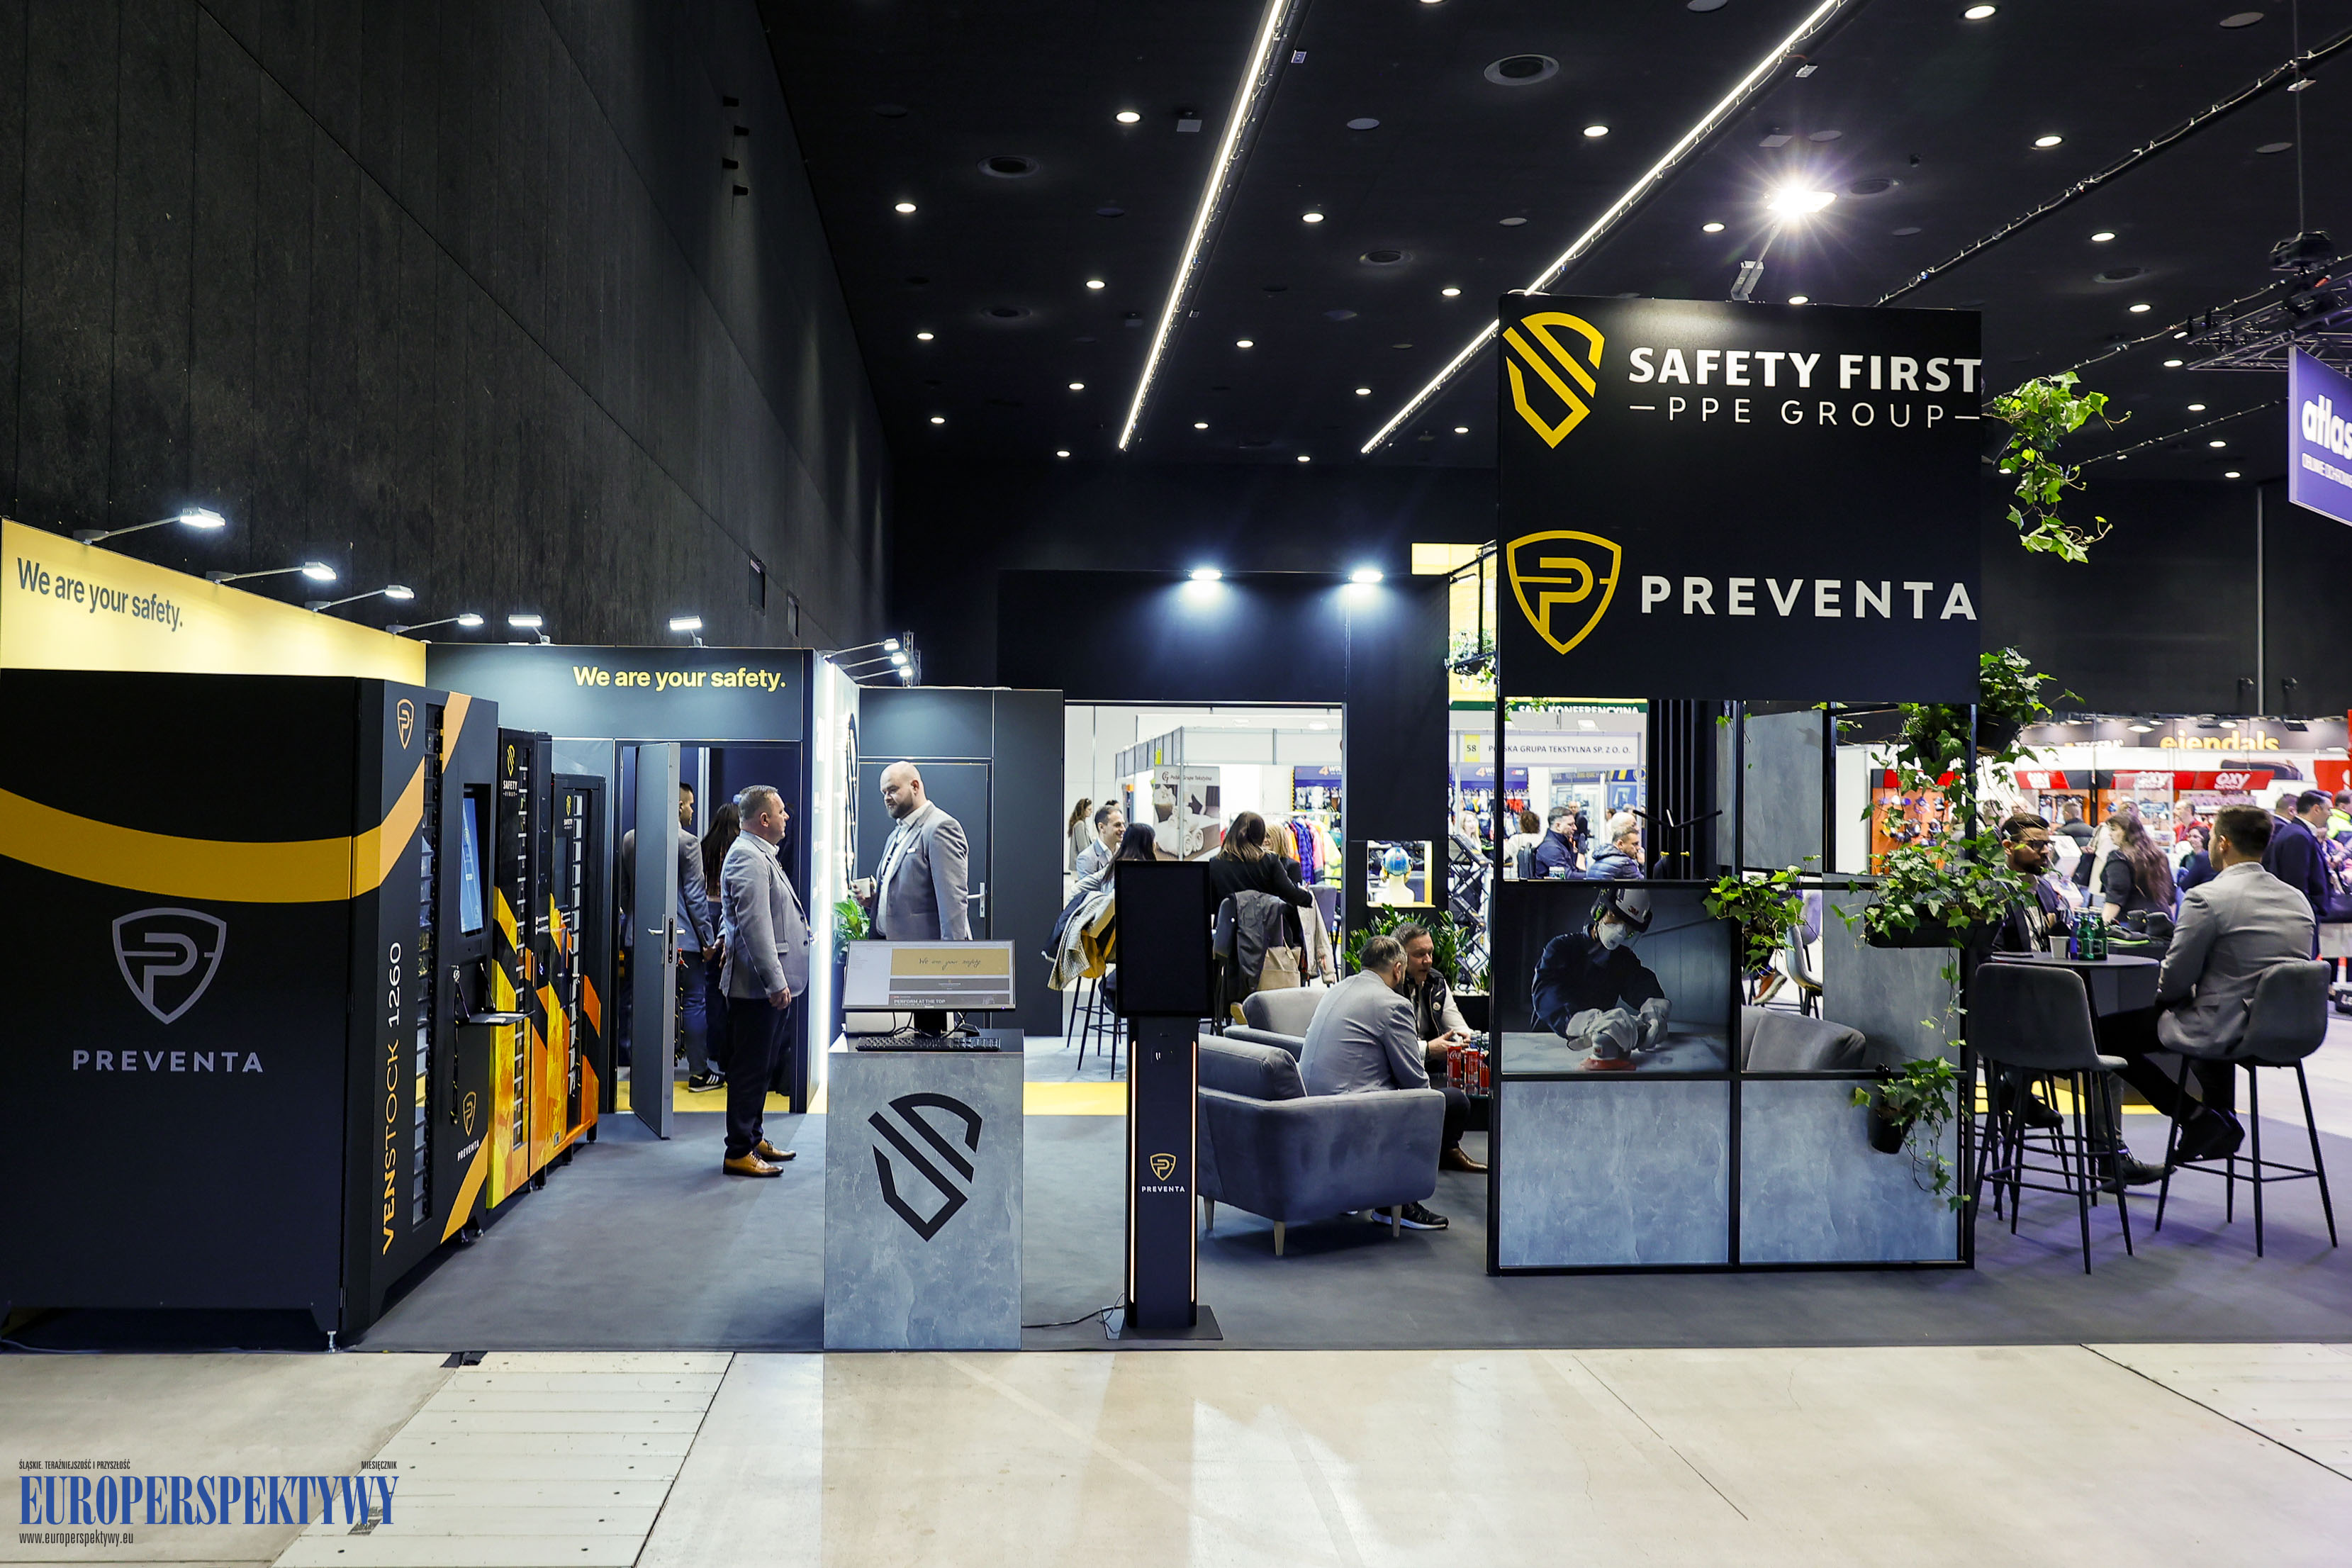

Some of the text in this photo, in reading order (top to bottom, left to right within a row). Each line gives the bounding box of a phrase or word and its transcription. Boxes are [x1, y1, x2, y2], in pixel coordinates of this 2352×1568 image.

[1628, 347, 1981, 393] SAFETY FIRST
[1669, 397, 1944, 429] PPE GROUP
[18, 557, 184, 632] We are your safety.
[1641, 575, 1978, 621] PREVENTA
[573, 666, 787, 692] We are your safety.
[503, 780, 518, 790] SAFETY
[72, 1049, 264, 1073] PREVENTA
[382, 941, 402, 1255] VENSTOCK 1260
[457, 1139, 480, 1162] PREVENTA
